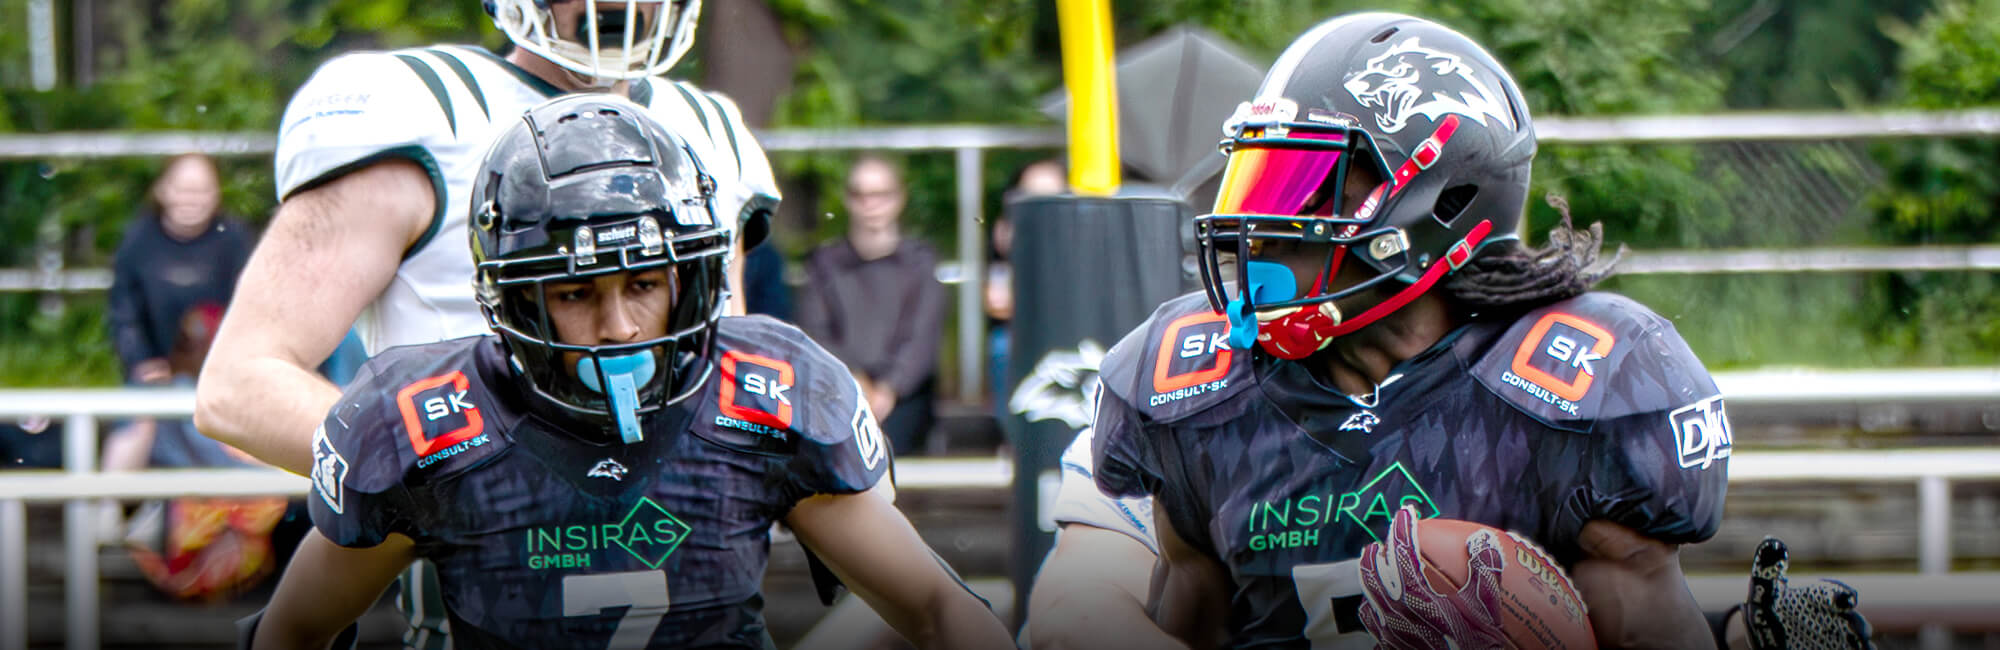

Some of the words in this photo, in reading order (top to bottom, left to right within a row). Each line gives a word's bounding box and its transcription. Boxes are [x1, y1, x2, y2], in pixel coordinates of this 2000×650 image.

[1180, 332, 1232, 359] SK
[1546, 335, 1602, 377] SK
[424, 389, 476, 422] SK
[743, 373, 792, 406] SK
[1149, 379, 1229, 408] CONSULT-SK
[1502, 371, 1580, 417] CONSULT-SK
[416, 433, 491, 470] CONSULT-SK
[527, 518, 678, 553] INSIRAS
[1249, 529, 1321, 551] GMBH
[528, 552, 592, 570] GMBH
